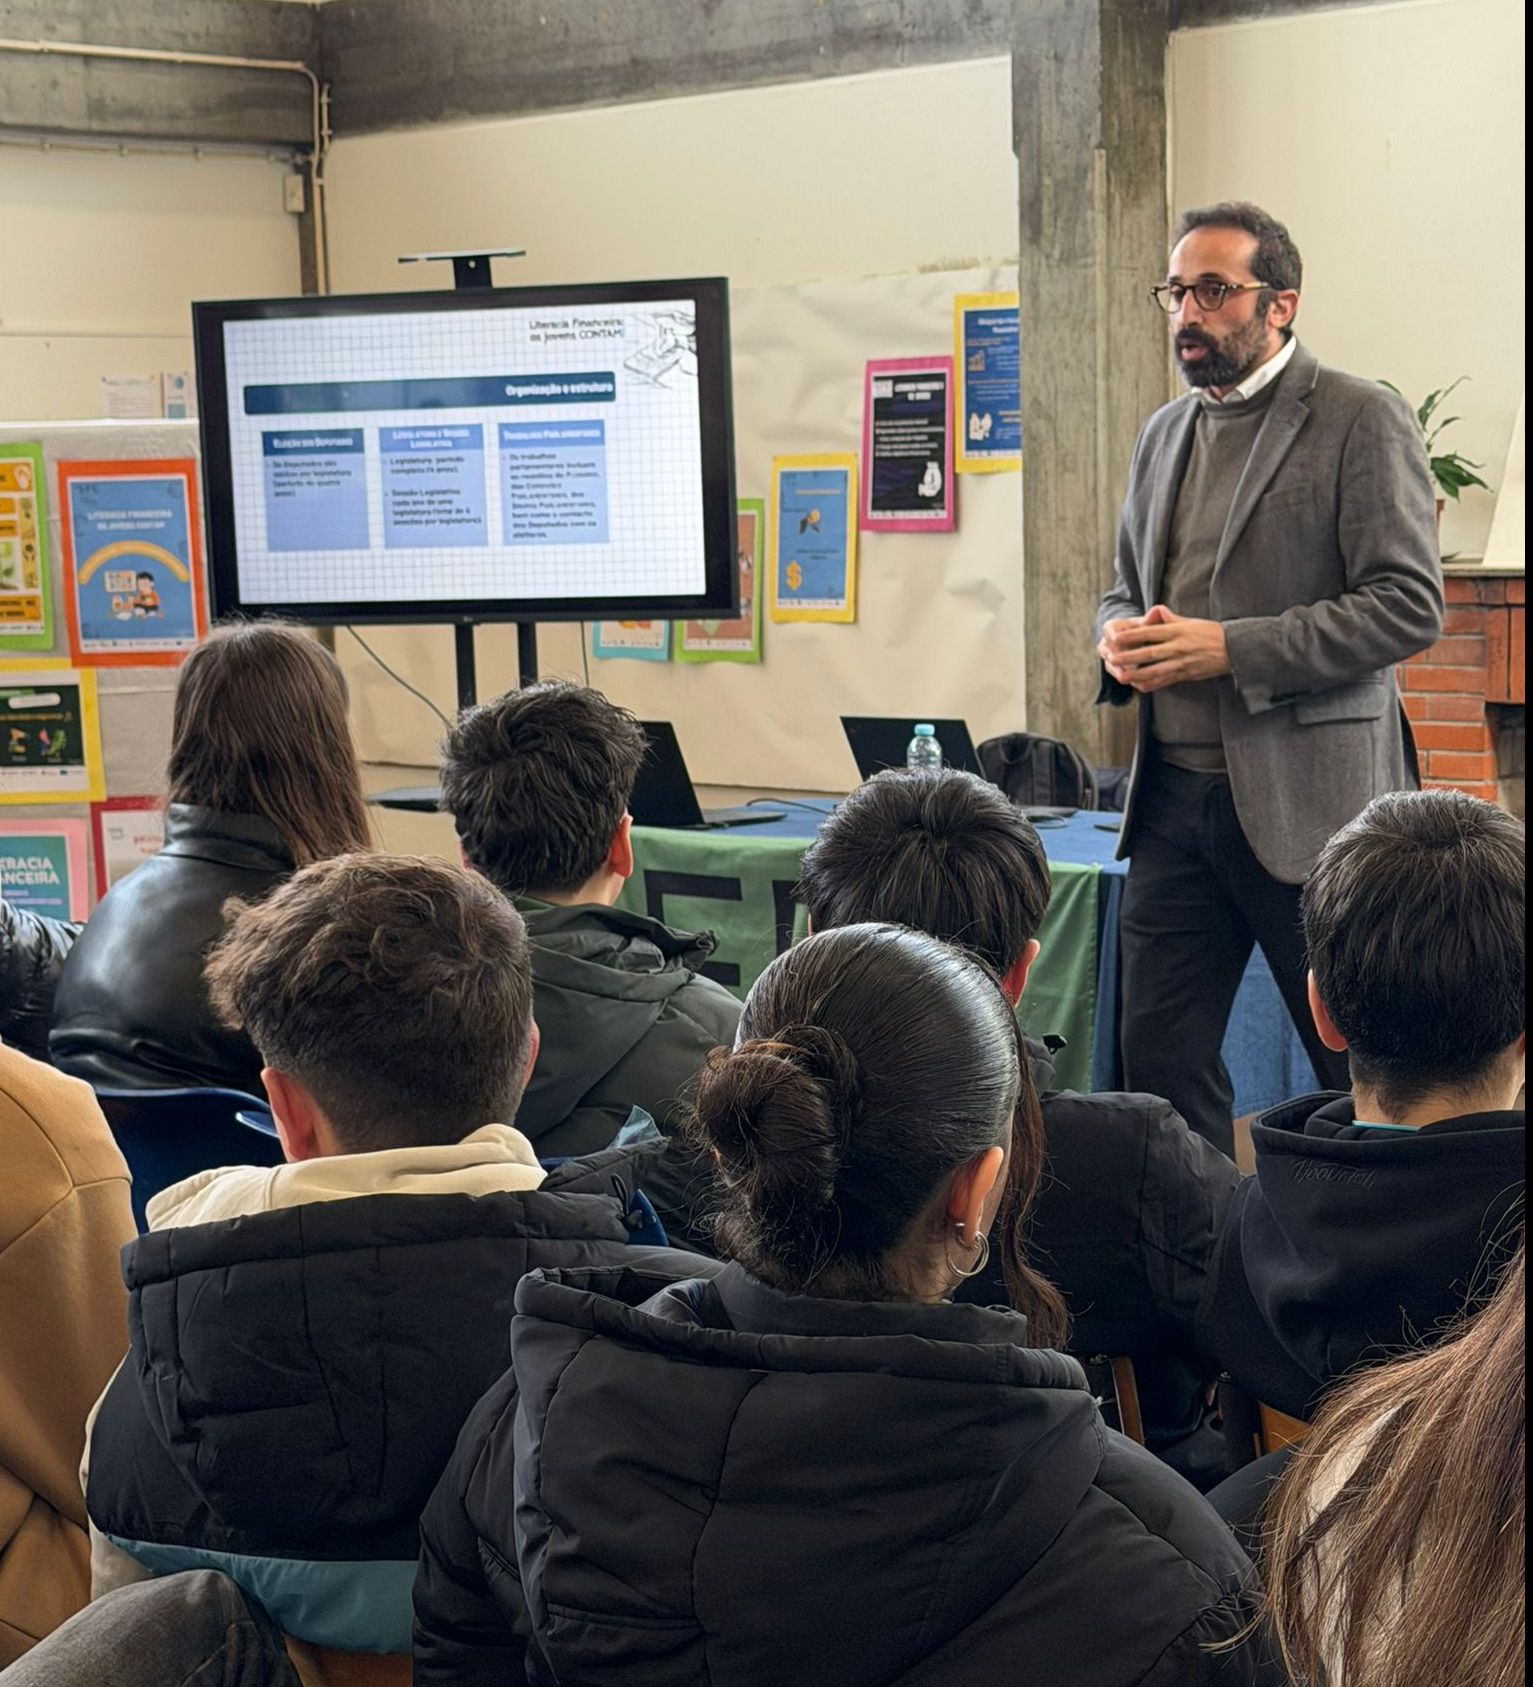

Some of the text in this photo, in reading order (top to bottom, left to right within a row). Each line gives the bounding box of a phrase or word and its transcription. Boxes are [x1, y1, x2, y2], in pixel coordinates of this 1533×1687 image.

[505, 382, 614, 397] Organização e estrutura
